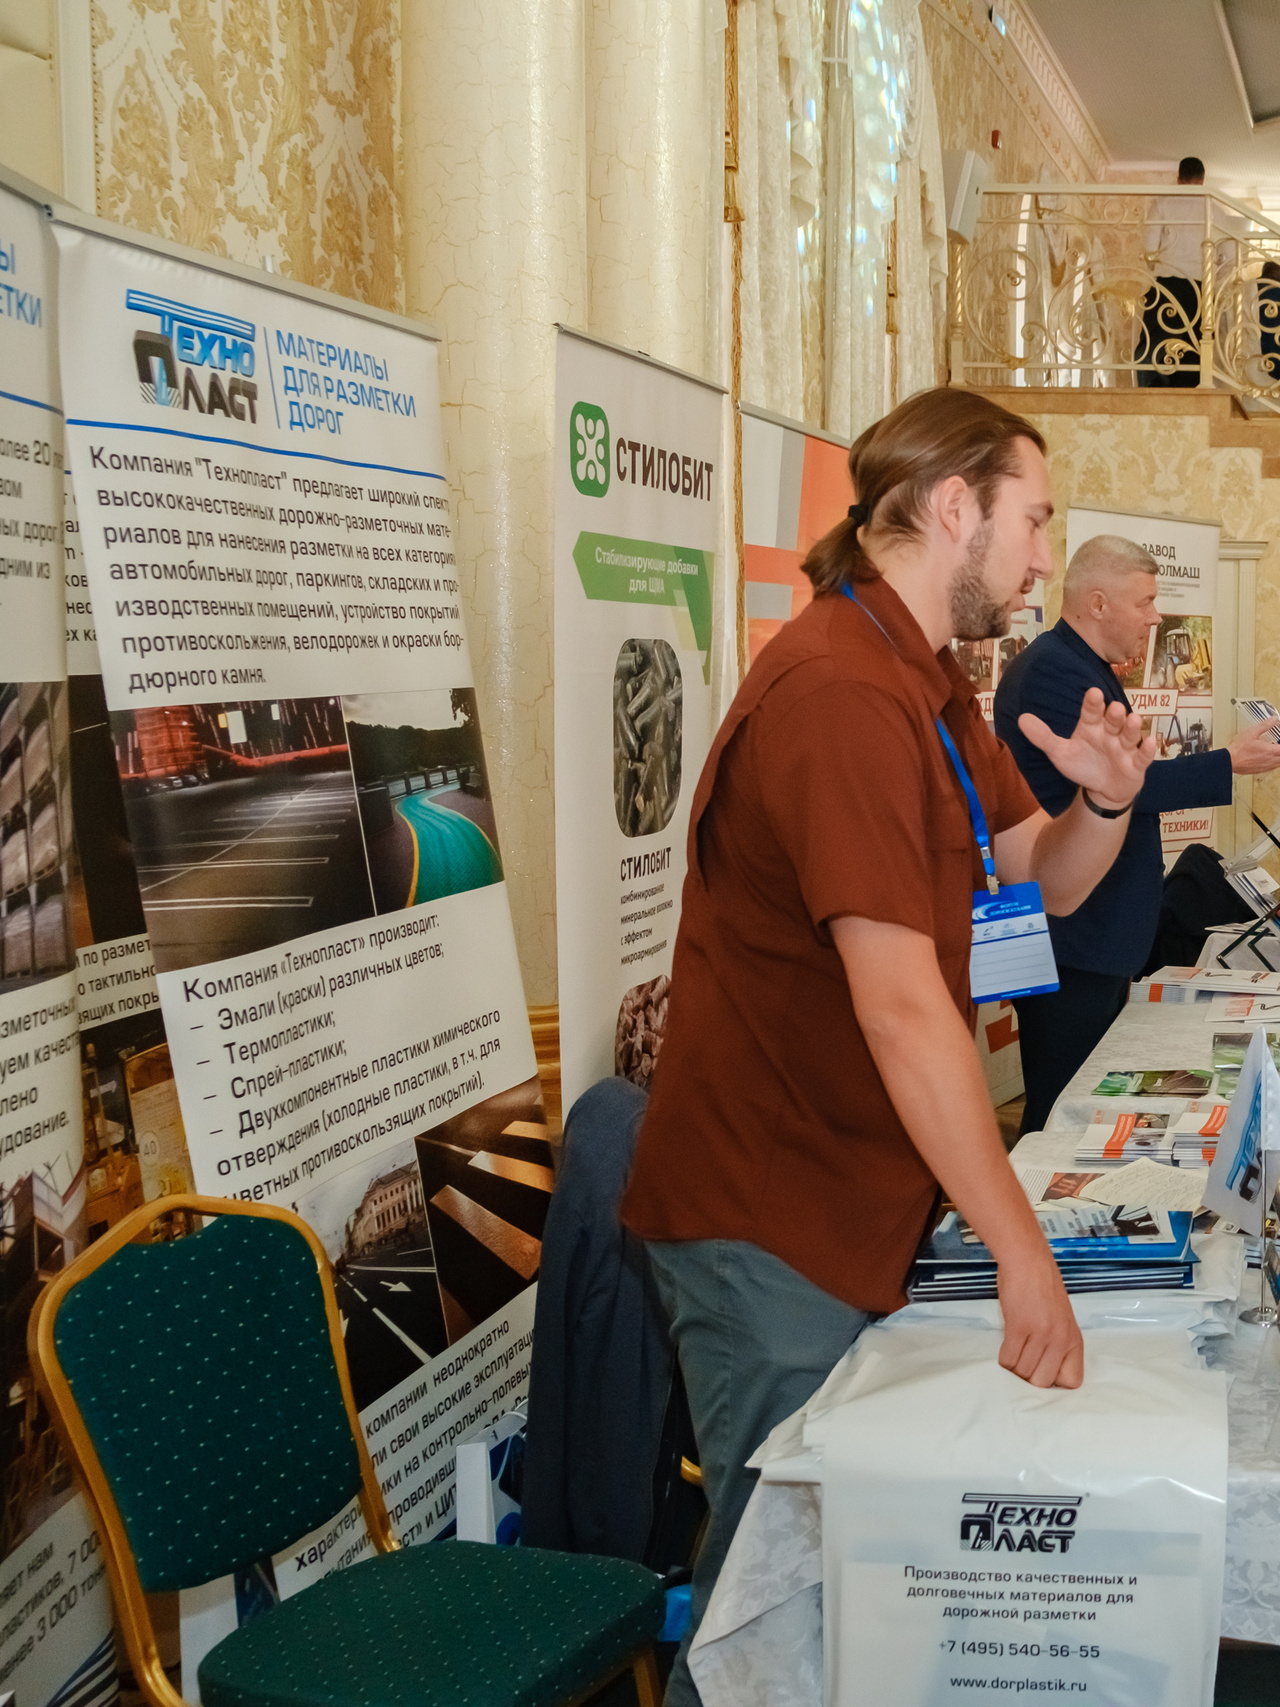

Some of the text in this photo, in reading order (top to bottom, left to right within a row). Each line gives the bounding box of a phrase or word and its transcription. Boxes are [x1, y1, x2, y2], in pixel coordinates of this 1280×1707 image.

[276, 330, 389, 382] МАТЕРИАЛЫ
[283, 366, 417, 418] ДЛЯ РАЗМЕТКИ
[290, 401, 344, 435] ДОРОГ
[89, 445, 193, 477] Компания
[293, 477, 363, 500] предлагает
[368, 488, 421, 508] широкий
[616, 437, 714, 501] СТИЛОБИТ
[97, 489, 276, 521] высококачественных
[279, 508, 425, 535] дорожно-разметочных
[103, 526, 182, 550] риалов
[187, 530, 215, 550] для
[219, 532, 287, 556] нанесения
[290, 540, 354, 560] разметки
[356, 545, 370, 560] на
[373, 546, 402, 561] всех
[109, 560, 253, 583] автомобильных
[256, 569, 293, 591] дорог,
[296, 571, 367, 592] паркингов,
[368, 576, 432, 593] складских
[434, 580, 441, 591] и
[667, 558, 699, 576] добавки
[629, 579, 647, 593] для
[115, 600, 460, 623] изводственных помещений, устройство покрытий
[122, 634, 291, 658] противоскольжения,
[293, 634, 380, 653] велодорожек
[382, 635, 389, 648] и
[392, 634, 442, 652] окраски
[129, 668, 267, 694] дюрного камня.
[1131, 694, 1170, 709] УДМ 82
[1163, 819, 1209, 833] ТЕХНИКИ!
[621, 847, 671, 881] СТИЛОБИТ
[183, 963, 278, 1002] Компания
[281, 936, 365, 974] «Технопласт»
[217, 999, 276, 1030] Эмали
[277, 975, 327, 1014] (краски)
[329, 956, 403, 997] различных
[223, 1010, 336, 1064] Термопластики;
[238, 1010, 501, 1139] Двухкомпонентные пластики химического
[217, 1118, 321, 1176] отверждения
[321, 1087, 391, 1132] (холодные
[394, 1061, 452, 1097] пластики,
[452, 1056, 459, 1070] в
[480, 1038, 501, 1060] для
[301, 1102, 426, 1179] противоскользящих
[428, 1070, 485, 1112] покрытий).
[365, 1381, 428, 1439] компании
[432, 1320, 510, 1388] неоднократно
[390, 1421, 420, 1454] свои
[422, 1381, 472, 1430] высокие
[404, 1456, 420, 1478] на
[425, 1511, 433, 1529] и
[904, 1565, 1138, 1586] Производство качественных и
[50, 1585, 78, 1628] 000
[906, 1587, 1134, 1605] долговечных материалов для
[942, 1605, 1097, 1622] дорожной разметки
[938, 1640, 1100, 1658] +7 (495) 540-56-55
[950, 1676, 1087, 1693] www.dorplastik.ru
